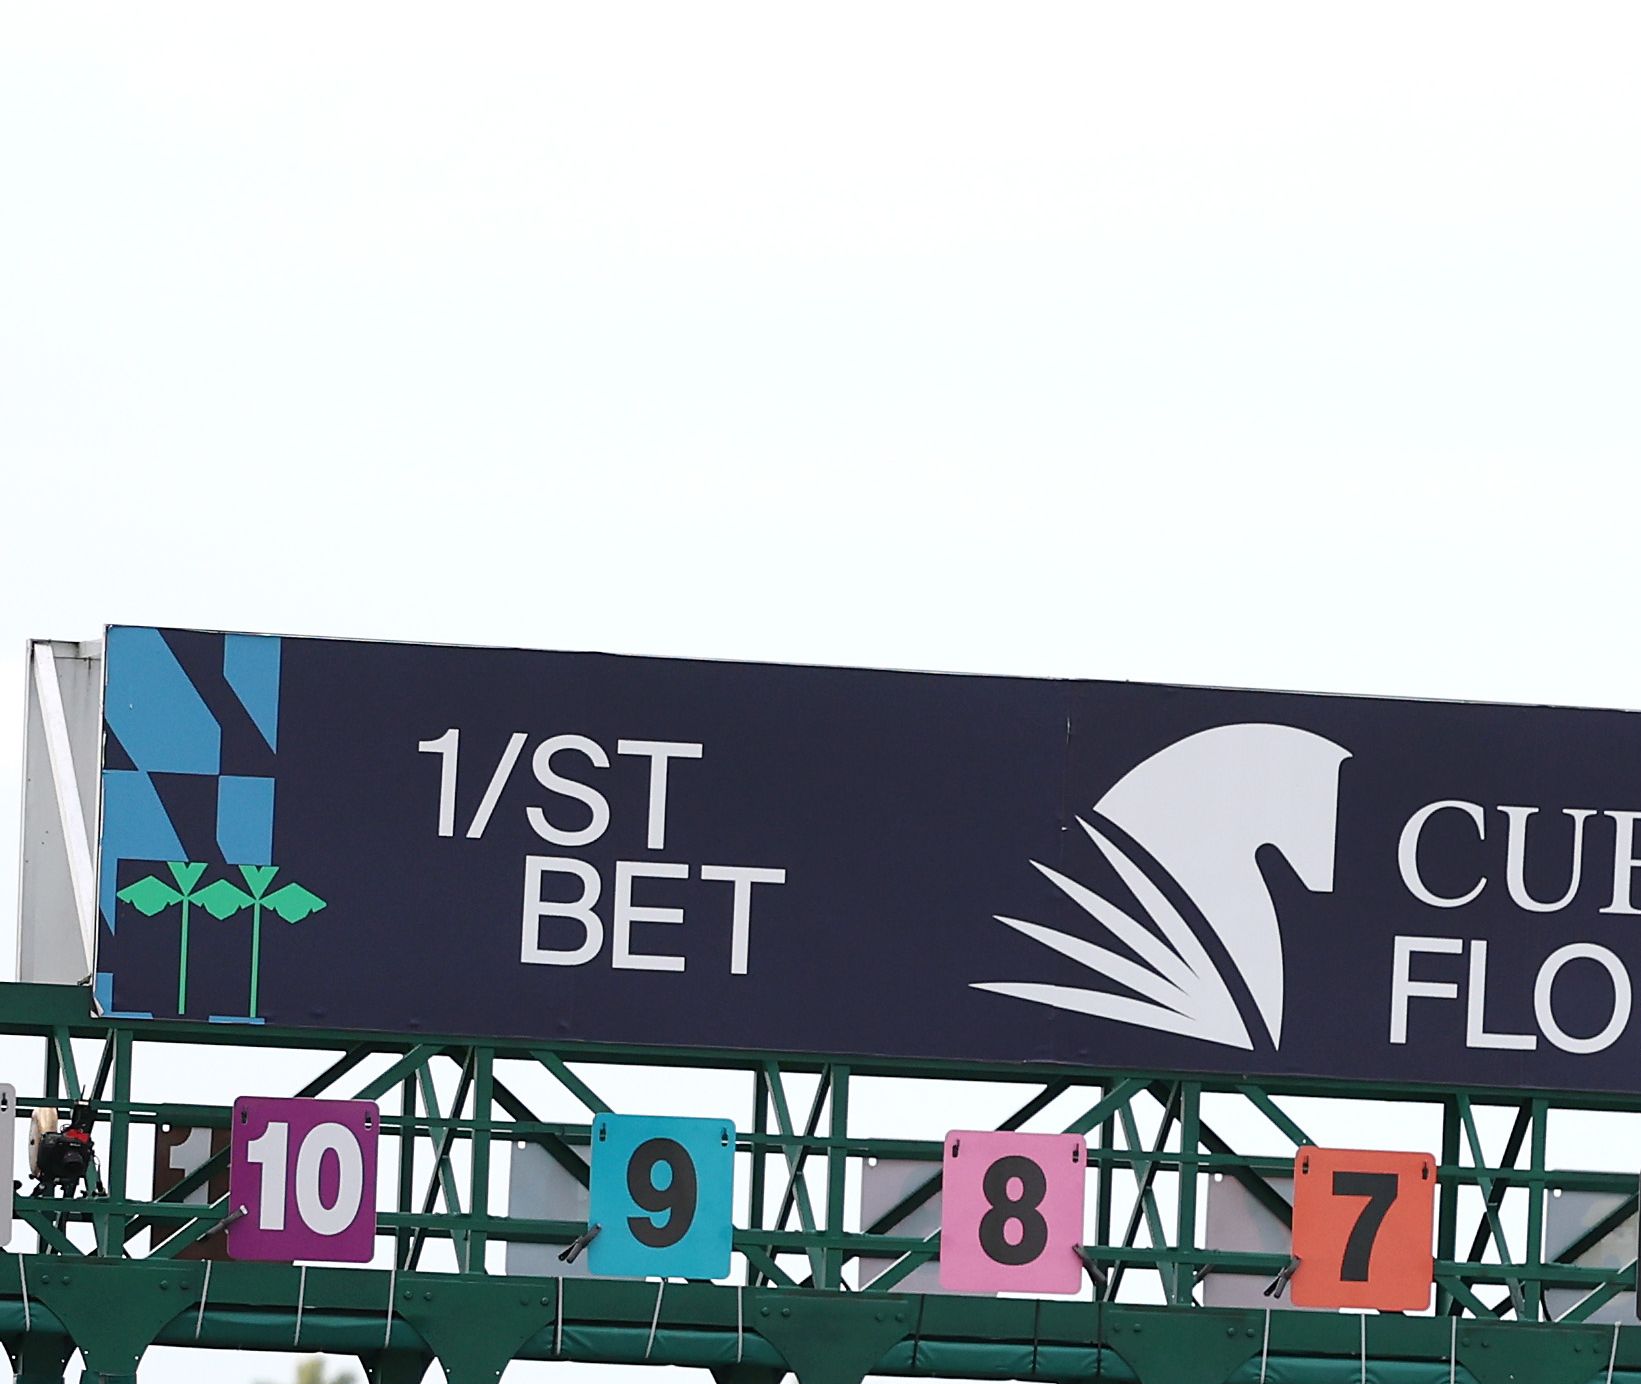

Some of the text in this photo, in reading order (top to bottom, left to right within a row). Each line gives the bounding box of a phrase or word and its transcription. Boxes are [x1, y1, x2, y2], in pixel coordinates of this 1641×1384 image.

[418, 728, 703, 850] 1/ST
[520, 855, 786, 975] BET
[247, 1121, 363, 1236] 10
[626, 1137, 698, 1249] 9
[978, 1155, 1048, 1266] 8
[1332, 1171, 1399, 1282] 7
